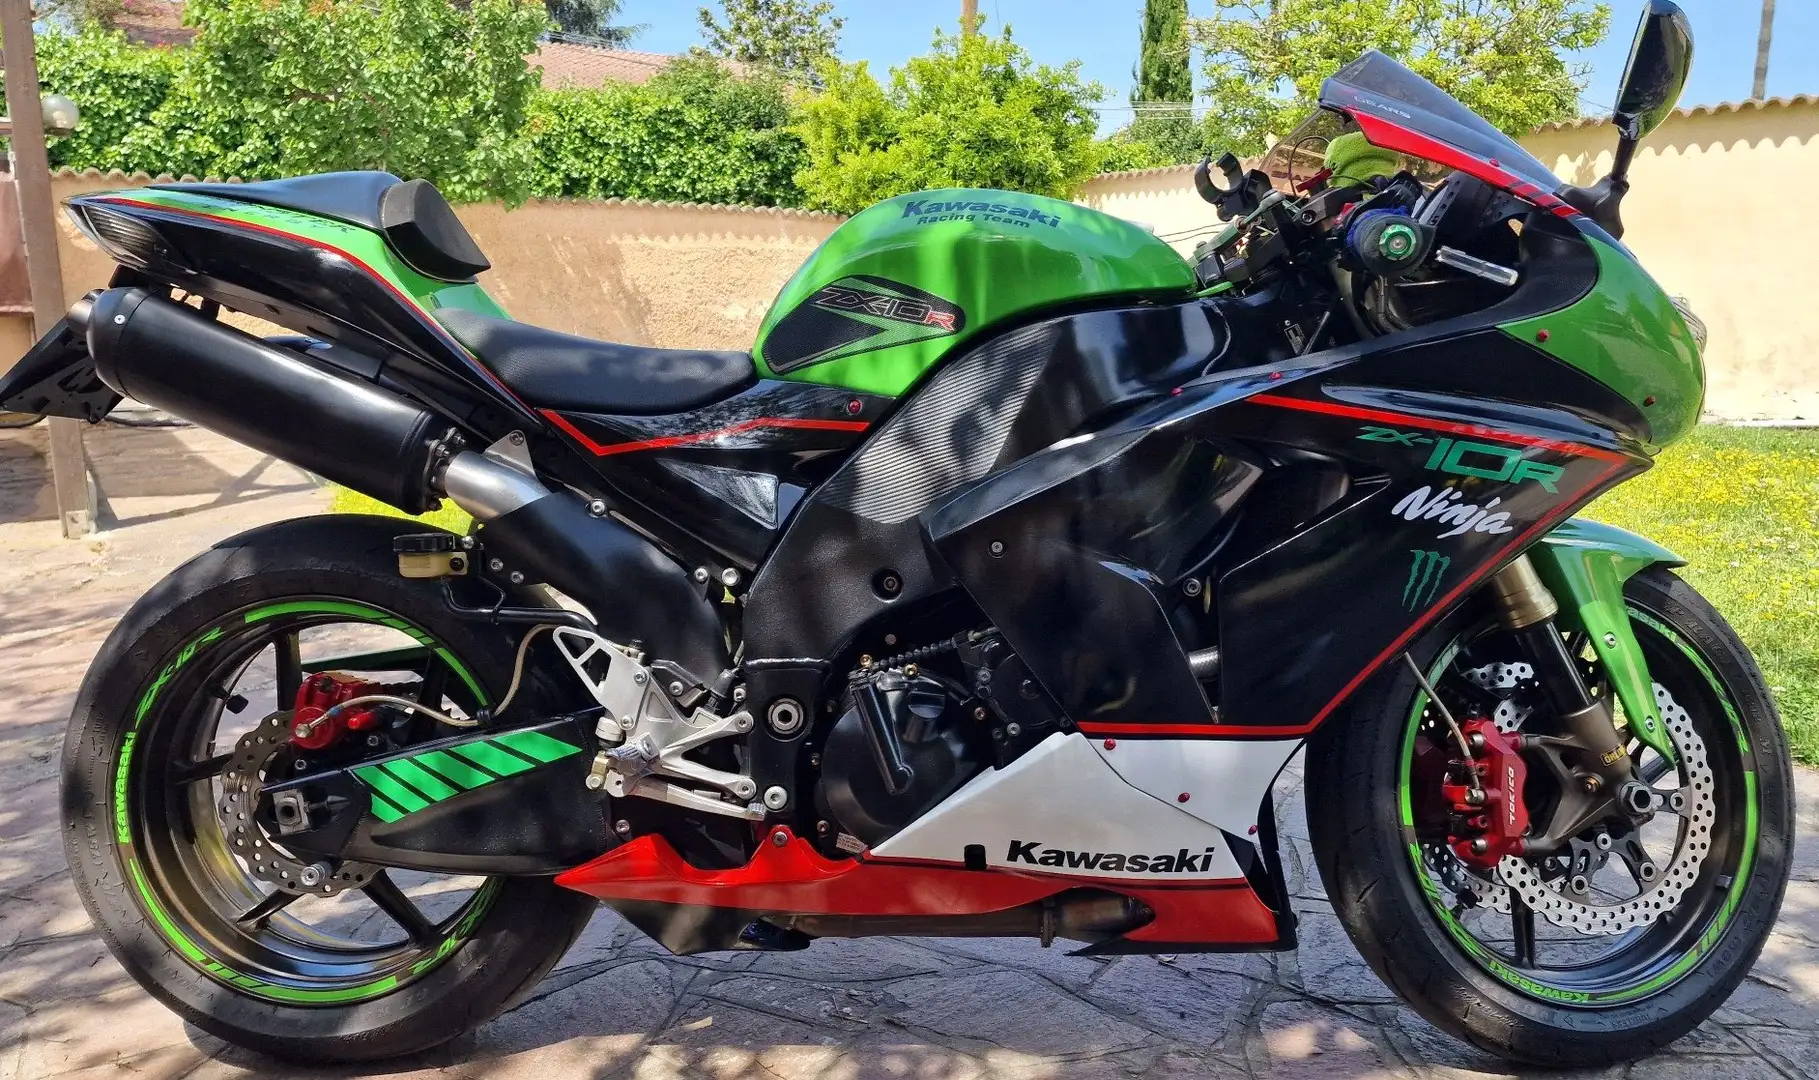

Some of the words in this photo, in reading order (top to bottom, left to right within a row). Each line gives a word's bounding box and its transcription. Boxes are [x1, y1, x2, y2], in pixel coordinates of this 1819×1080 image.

[902, 200, 1062, 228] Kawasaki
[916, 213, 976, 225] Racing
[983, 213, 1030, 228] Team
[1355, 425, 1566, 494] ZX-10R
[1391, 485, 1514, 540] Ninja
[1627, 606, 1677, 643] asaki
[114, 731, 137, 844] Kawasaki
[1508, 766, 1516, 826] TOKICO
[1006, 840, 1215, 873] Kawasaki
[1489, 960, 1590, 1004] Kawasaki
